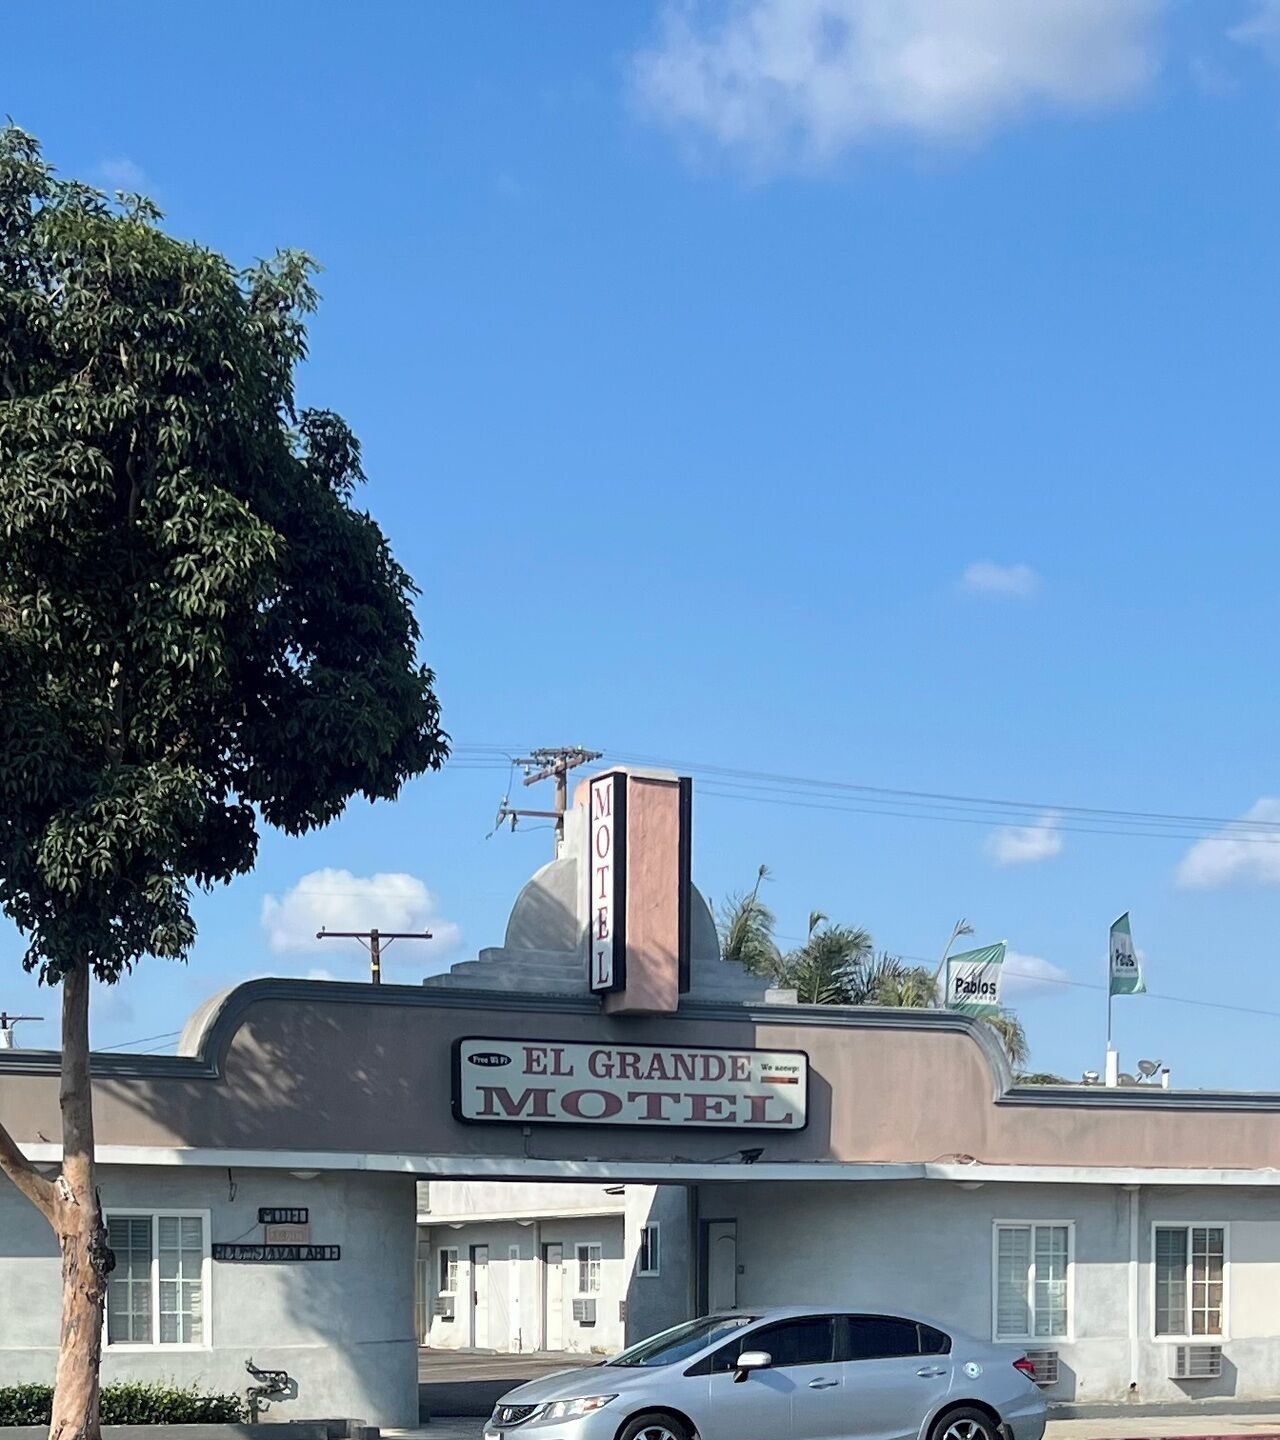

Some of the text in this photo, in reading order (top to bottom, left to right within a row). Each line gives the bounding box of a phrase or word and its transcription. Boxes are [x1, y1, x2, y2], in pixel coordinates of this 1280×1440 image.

[594, 783, 611, 985] MOTEL
[955, 976, 997, 995] Pablos
[522, 1046, 752, 1083] EL GRANDE
[761, 1063, 773, 1071] We
[475, 1086, 793, 1124] MOTEL
